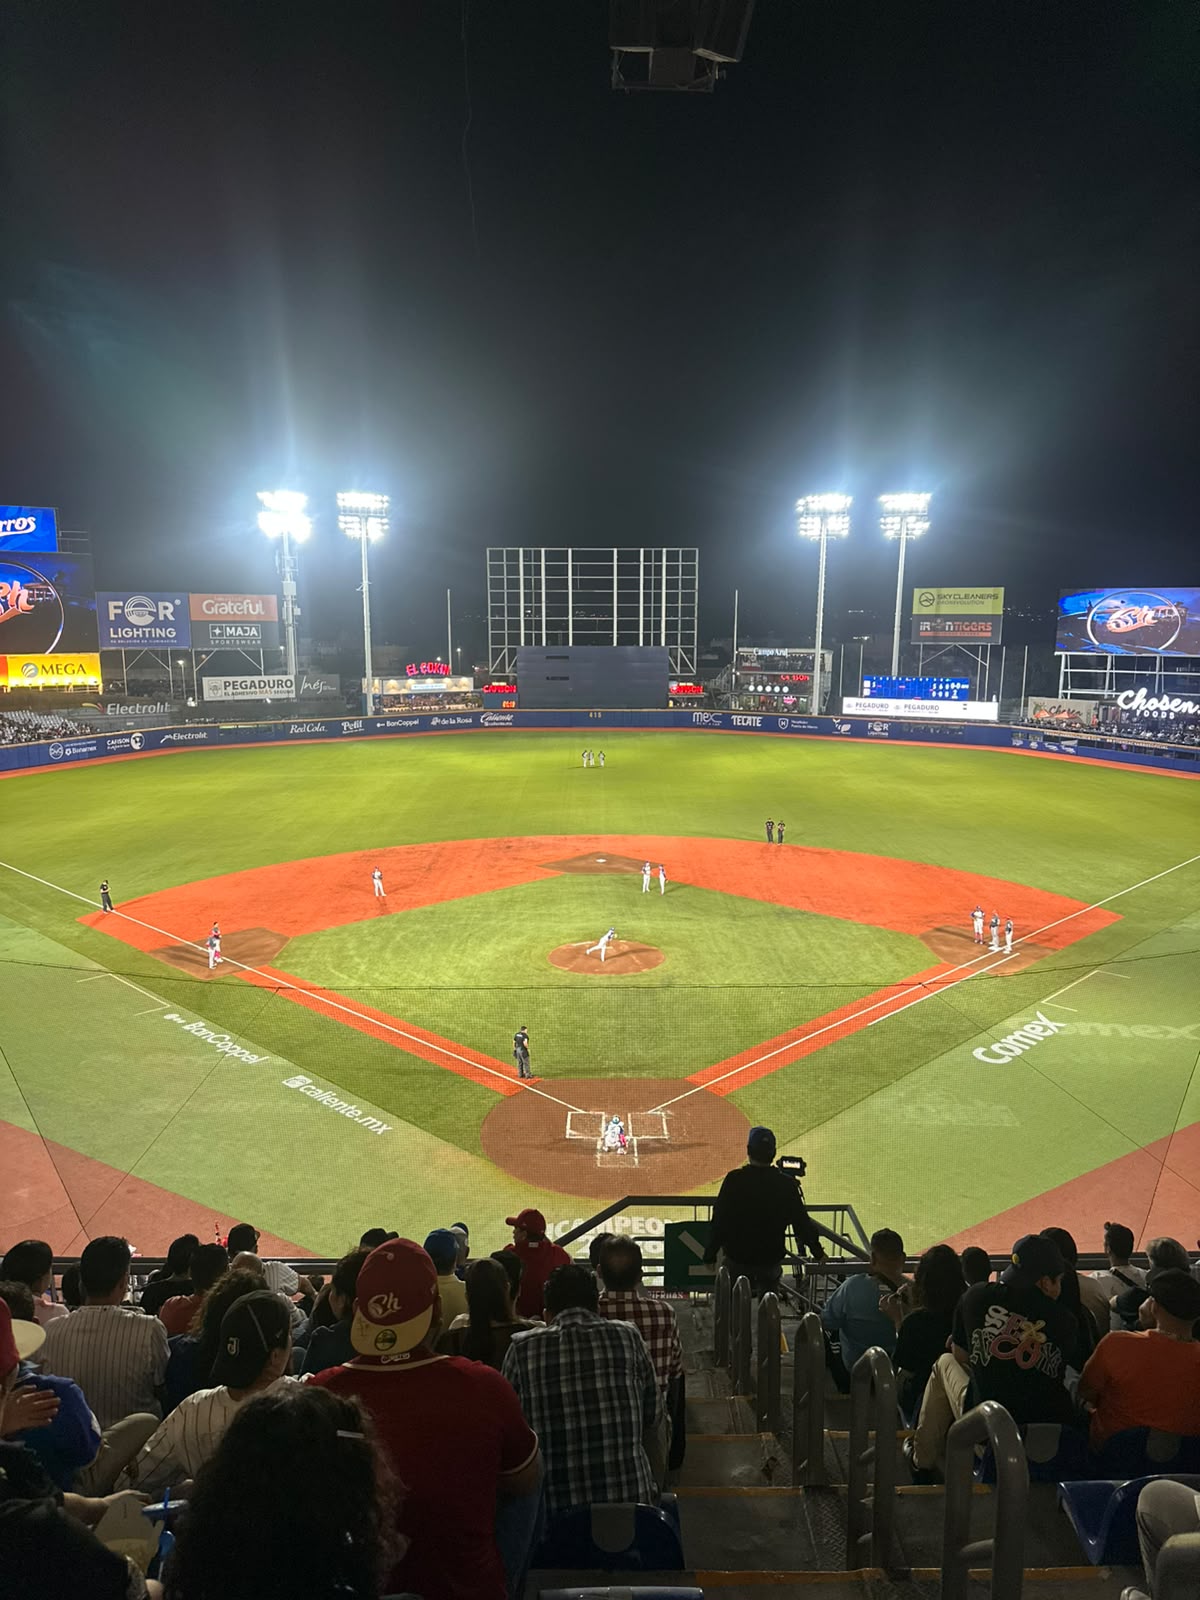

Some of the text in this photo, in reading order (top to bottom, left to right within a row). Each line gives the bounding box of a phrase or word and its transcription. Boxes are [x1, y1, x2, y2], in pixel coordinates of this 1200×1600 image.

[202, 599, 265, 615] Grateful
[110, 627, 177, 639] LIGHTING
[226, 627, 259, 637] MAJA
[40, 664, 87, 675] MEGA
[223, 679, 294, 690] PEGADURO
[107, 702, 171, 715] Electrolit
[731, 715, 762, 727] TECATE
[182, 1020, 270, 1065] BanCoppel
[972, 1010, 1068, 1064] Comex
[299, 1083, 394, 1136] caliente.mx
